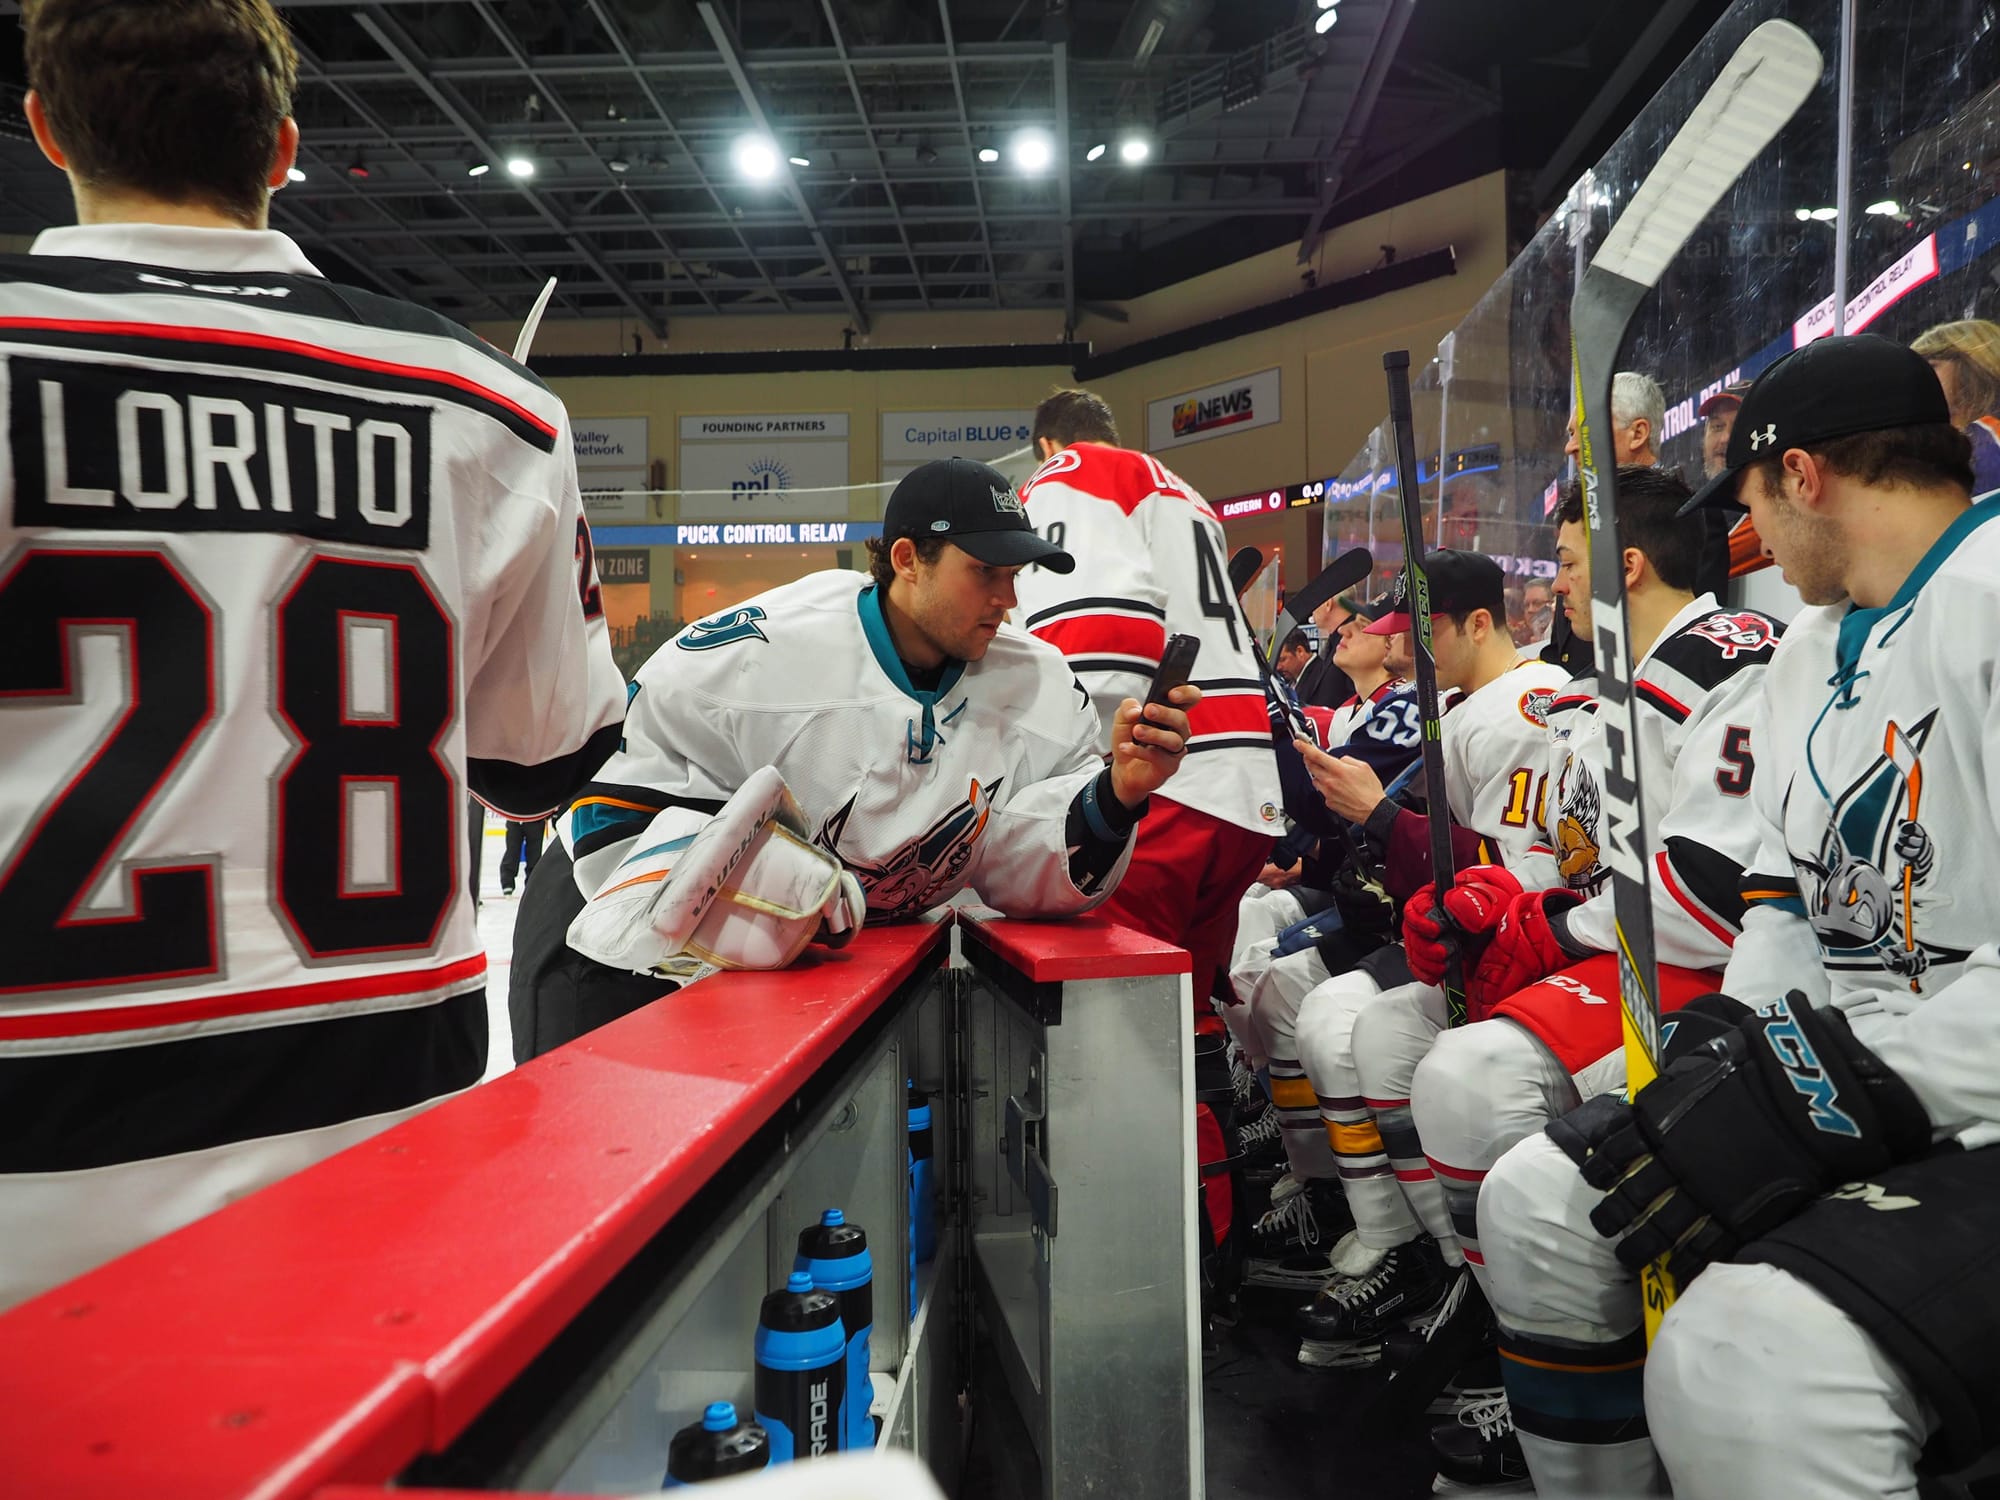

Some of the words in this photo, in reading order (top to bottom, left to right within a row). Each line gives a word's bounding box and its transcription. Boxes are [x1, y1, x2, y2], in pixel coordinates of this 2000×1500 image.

[1889, 254, 1914, 284] RELAY
[1198, 387, 1252, 421] NEWS
[702, 423, 764, 433] FOUNDING
[766, 421, 826, 432] PARTNERS
[1661, 397, 1697, 443] TROL
[574, 432, 609, 444] Valley
[905, 427, 962, 445] Capital
[39, 380, 412, 527] LORITO
[574, 444, 624, 455] Network
[732, 474, 769, 501] ppl
[1302, 482, 1323, 498] 0.0
[1223, 498, 1262, 516] EASTERN
[1269, 492, 1281, 509] 0
[677, 525, 719, 545] PUCK
[723, 524, 795, 544] CONTROL
[799, 523, 847, 543] RELAY
[608, 558, 644, 576] ZONE
[0, 540, 462, 998] 28
[692, 810, 767, 917] VAUGHN
[1532, 975, 1608, 1004] CM
